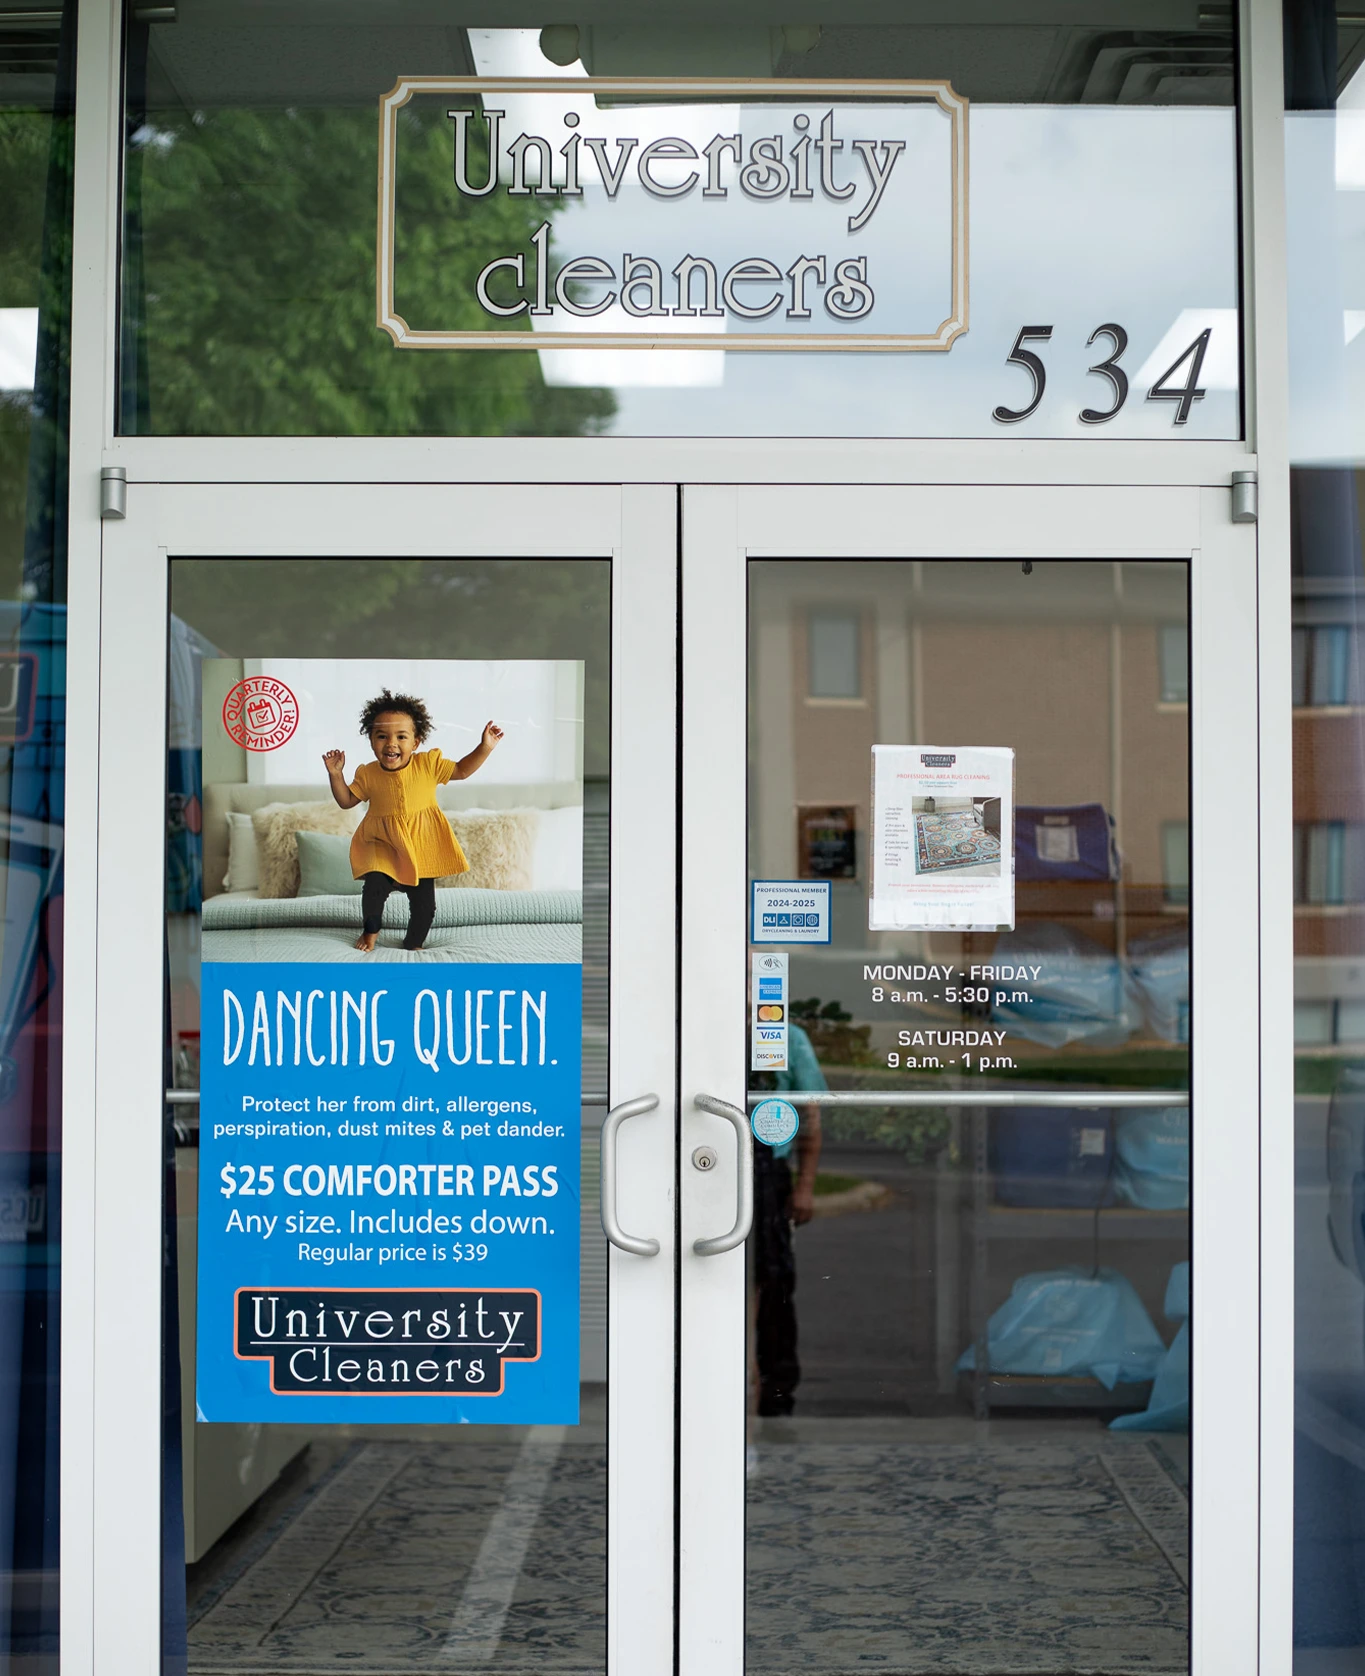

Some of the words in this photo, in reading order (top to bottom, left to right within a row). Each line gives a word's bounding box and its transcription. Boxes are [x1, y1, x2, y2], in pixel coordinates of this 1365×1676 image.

[447, 109, 906, 232] University
[476, 221, 875, 319] cleaners
[227, 680, 293, 721] QUARTERLY
[231, 709, 295, 748] REMINDER!
[764, 916, 776, 924] DLI
[863, 965, 954, 980] MONDAY
[970, 965, 1042, 980] FRIDAY
[872, 987, 884, 1002] 8
[890, 990, 928, 1002] a.m.
[945, 987, 989, 1002] 5:30
[995, 991, 1033, 1006] p.m.
[223, 989, 396, 1067] DANCING
[413, 989, 559, 1073] QUEEN.
[760, 1031, 782, 1039] VISA
[898, 1031, 1006, 1046] SATURDAY
[887, 1053, 900, 1068] 9
[906, 1056, 944, 1068] a.m.
[961, 1053, 971, 1068] 1
[979, 1056, 1017, 1072] p.m.
[242, 1096, 310, 1112] Protect
[317, 1096, 347, 1112] her
[353, 1096, 396, 1112] from
[402, 1096, 440, 1114] dirt,
[446, 1096, 537, 1116] allergens,
[214, 1120, 331, 1139] perspiration,
[338, 1120, 378, 1136] dust
[386, 1121, 436, 1136] mites
[442, 1120, 454, 1136] &
[461, 1122, 491, 1140] pet
[497, 1120, 565, 1137] dander.
[220, 1162, 275, 1198] $25
[283, 1164, 474, 1196] COMFORTER
[483, 1165, 558, 1197] PASS
[226, 1209, 278, 1240] Any
[286, 1210, 341, 1234] size.
[350, 1209, 462, 1234] Includes
[470, 1209, 555, 1235] down.
[298, 1242, 373, 1266] Regular
[379, 1244, 427, 1265] price
[432, 1244, 446, 1261] is
[453, 1242, 488, 1262] $39
[252, 1296, 524, 1353] University
[289, 1346, 486, 1383] Cleaners
